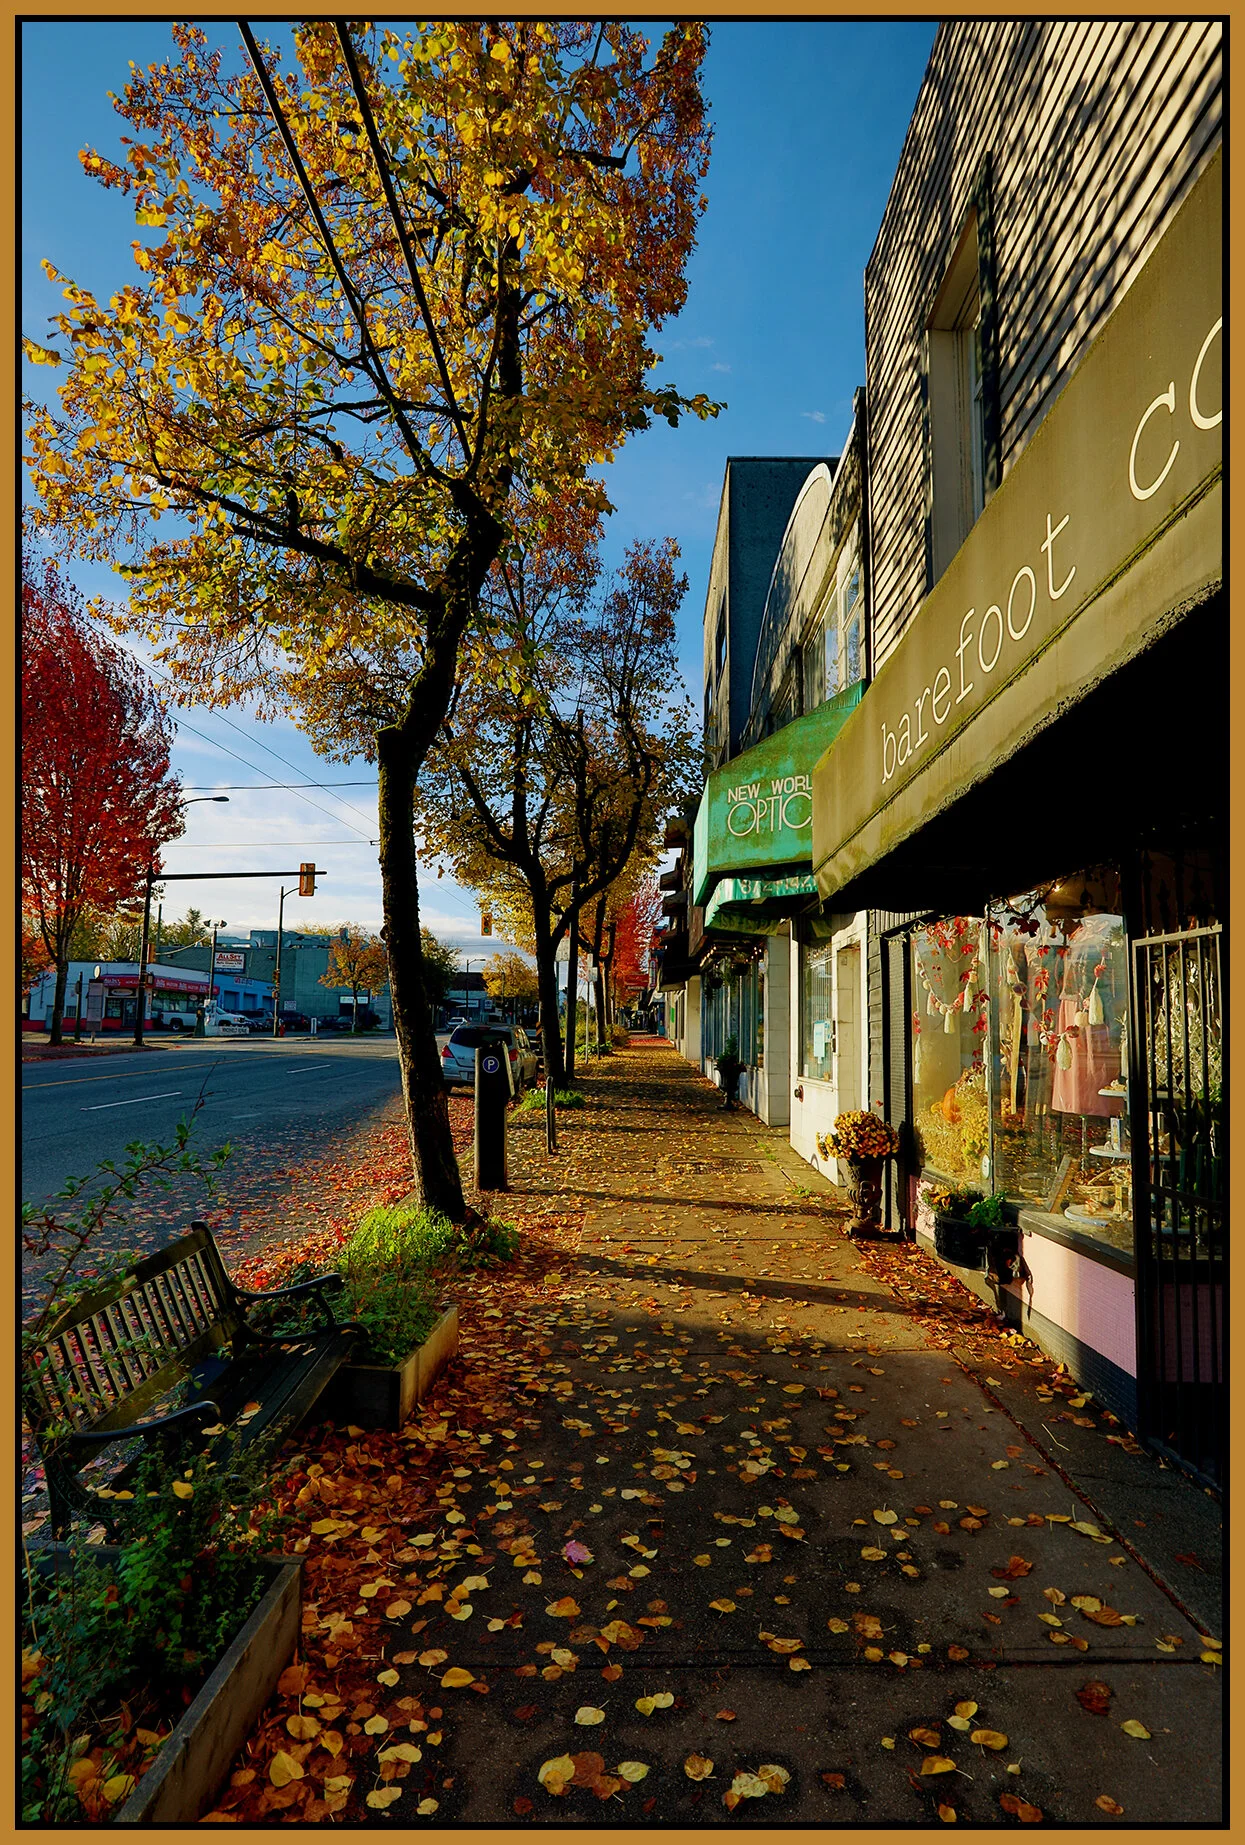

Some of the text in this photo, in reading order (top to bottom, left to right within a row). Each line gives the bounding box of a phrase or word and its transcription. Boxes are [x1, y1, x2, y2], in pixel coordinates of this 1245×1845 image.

[880, 513, 1076, 784] barefoot
[727, 774, 813, 803] NEW WORL
[727, 791, 813, 837] OPTIC
